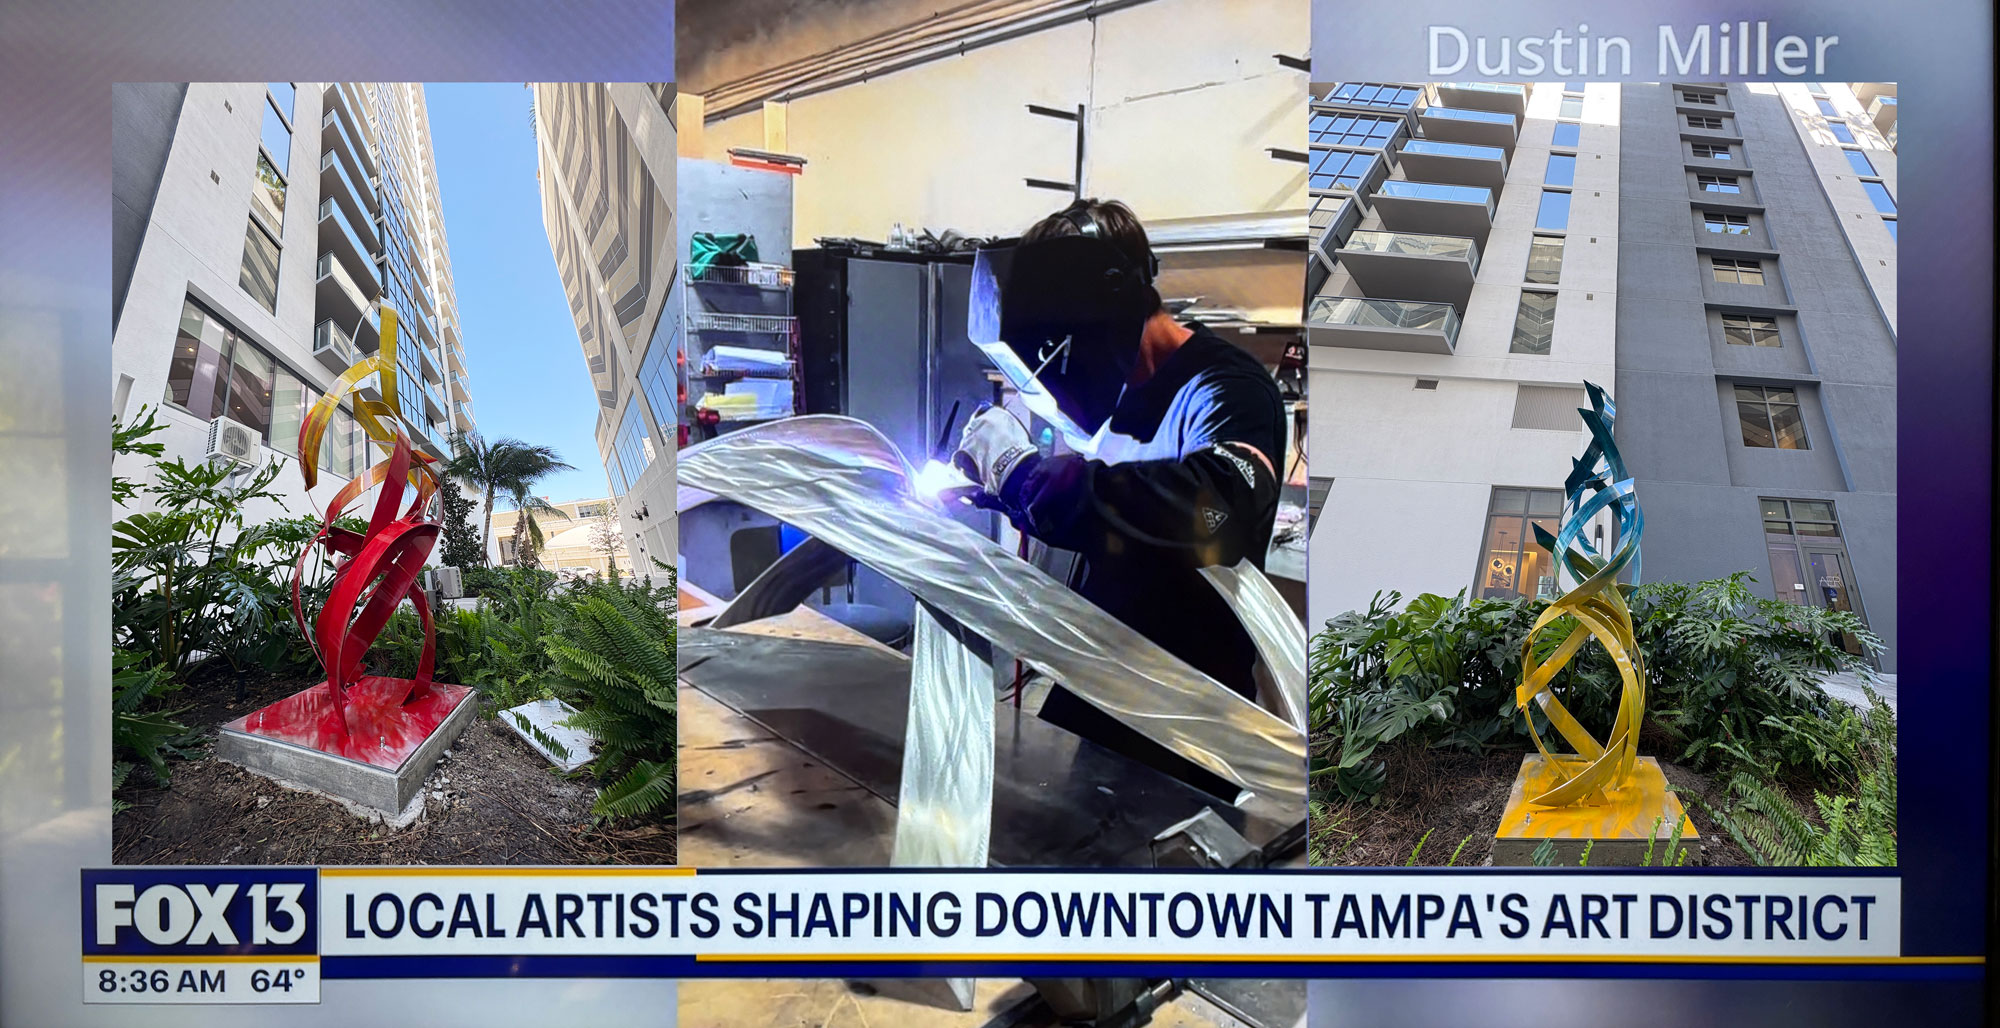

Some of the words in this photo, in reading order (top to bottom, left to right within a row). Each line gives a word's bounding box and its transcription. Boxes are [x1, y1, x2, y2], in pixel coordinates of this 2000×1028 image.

[96, 884, 239, 945] FOX
[247, 884, 306, 945] 13
[346, 892, 505, 940] LOCAL
[516, 892, 720, 940] ARTISTS
[733, 891, 962, 939] SHAPING
[976, 891, 1293, 939] DOWNTOWN
[1305, 892, 1530, 940] TAMPA'S
[1541, 894, 1638, 940] ART
[1650, 894, 1877, 941] DISTRICT
[98, 968, 170, 993] 8:36
[177, 969, 226, 993] AM
[250, 968, 305, 993] 64°
